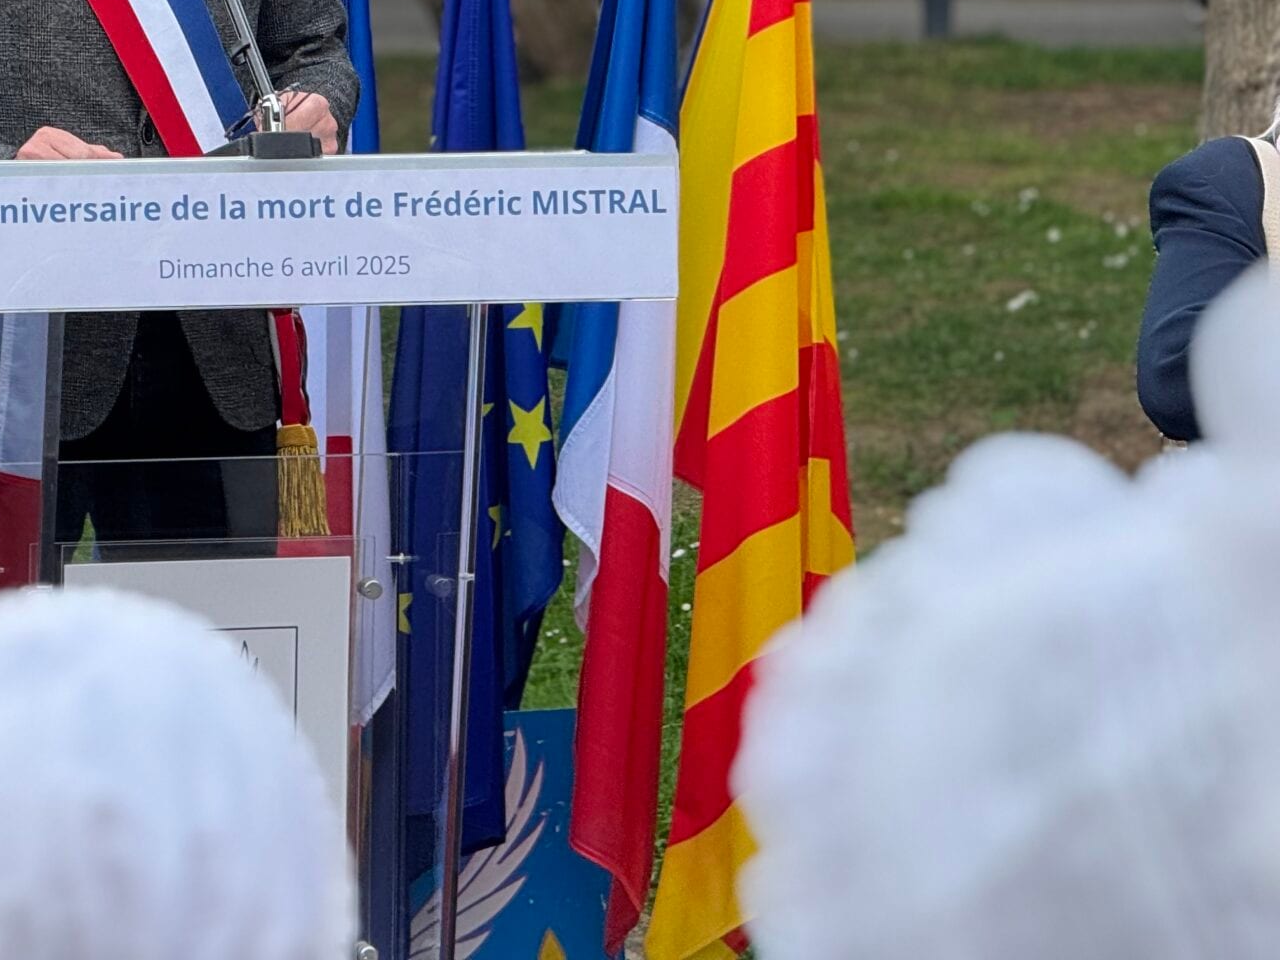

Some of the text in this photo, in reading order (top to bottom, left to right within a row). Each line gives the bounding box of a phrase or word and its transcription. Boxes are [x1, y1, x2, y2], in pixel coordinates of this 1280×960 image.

[171, 193, 210, 222] de
[219, 193, 247, 221] la
[257, 194, 336, 221] mort
[344, 191, 384, 219] de
[393, 189, 523, 218] Frédéric
[532, 188, 668, 216] MISTRAL
[159, 254, 412, 280] Dimanche 6 avril 2025
